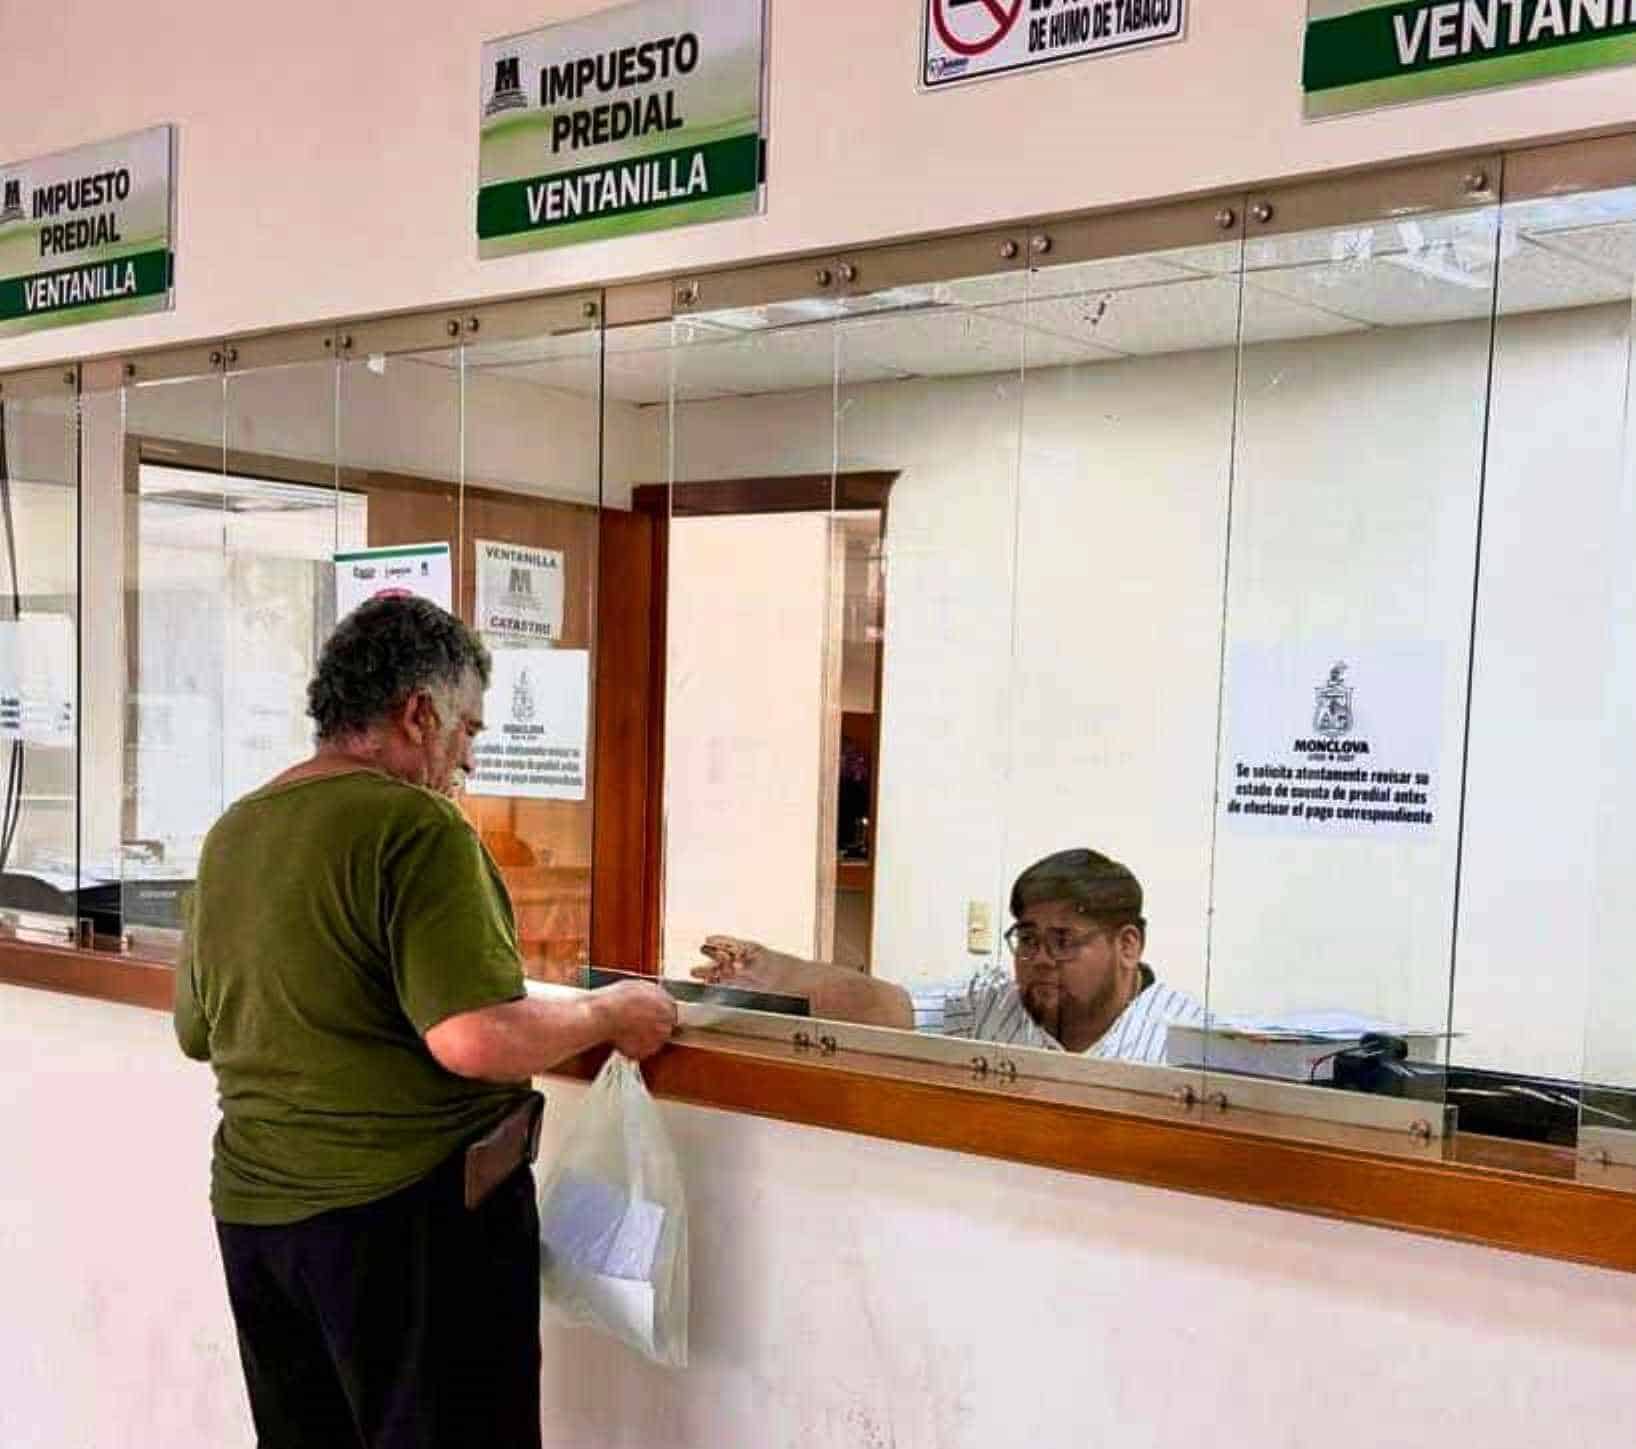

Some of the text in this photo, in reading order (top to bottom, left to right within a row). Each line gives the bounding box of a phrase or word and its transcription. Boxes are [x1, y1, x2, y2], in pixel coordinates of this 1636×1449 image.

[1028, 0, 1172, 52] DE HUMO DE TABACO
[1393, 0, 1636, 65] VENTANI
[540, 32, 699, 107] IMPUESTO
[552, 90, 684, 153] PREDIAL
[32, 168, 130, 218] IMPUESTO
[527, 151, 709, 224] VENTANILLA
[40, 213, 121, 257] PREDIAL
[24, 261, 137, 311] VENTANILLA
[485, 545, 557, 569] VENTANILLA
[1294, 739, 1370, 754] MONCLOVA
[1236, 763, 1429, 786] Se solicita atentamente revisar su
[1236, 783, 1272, 797] estado
[1274, 783, 1288, 798] de
[1333, 785, 1346, 801] de
[1349, 786, 1391, 804] predial
[1394, 788, 1427, 805] antes
[1227, 799, 1241, 813] de
[1291, 801, 1304, 816] el
[1306, 805, 1334, 822] pago
[1336, 806, 1433, 825] correspondiente
